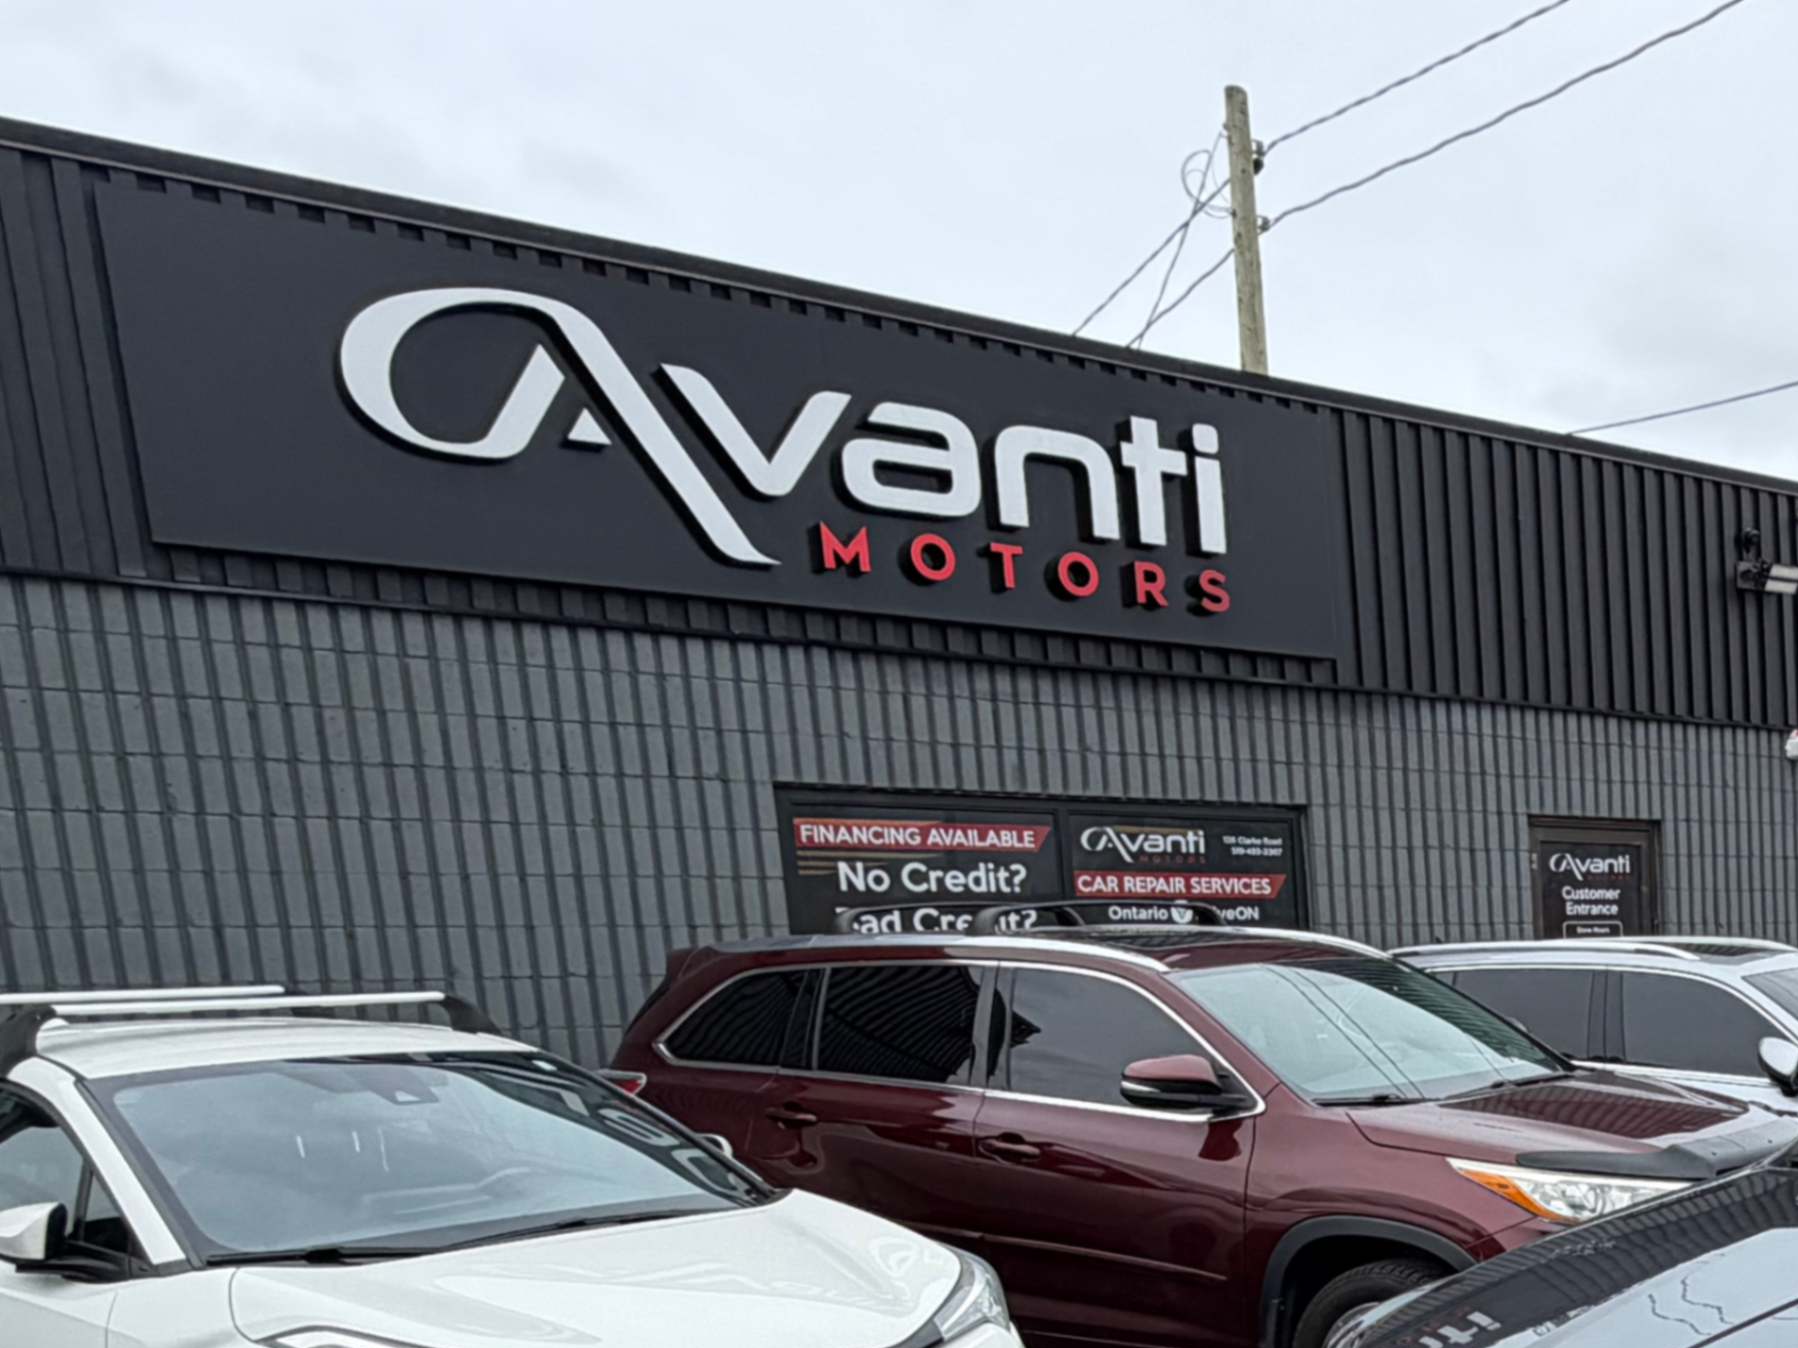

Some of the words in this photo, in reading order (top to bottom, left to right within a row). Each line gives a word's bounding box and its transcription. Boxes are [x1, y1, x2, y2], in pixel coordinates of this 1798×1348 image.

[341, 287, 1227, 565] Avanti
[819, 520, 1231, 612] MOTORS
[800, 824, 922, 845] FINANCING
[927, 829, 1036, 848] AVAILABLE
[1080, 826, 1206, 863] Avanti
[837, 861, 891, 893] No
[901, 862, 1027, 893] Credit?
[1550, 853, 1631, 881] Avanti
[1077, 875, 1119, 893] CAR
[1123, 876, 1186, 894] REPAIR
[1190, 877, 1272, 895] SERVICES
[1561, 886, 1620, 900] Customer
[835, 907, 900, 934] ad
[1108, 905, 1168, 921] Ontario
[1565, 902, 1618, 916] Entrance
